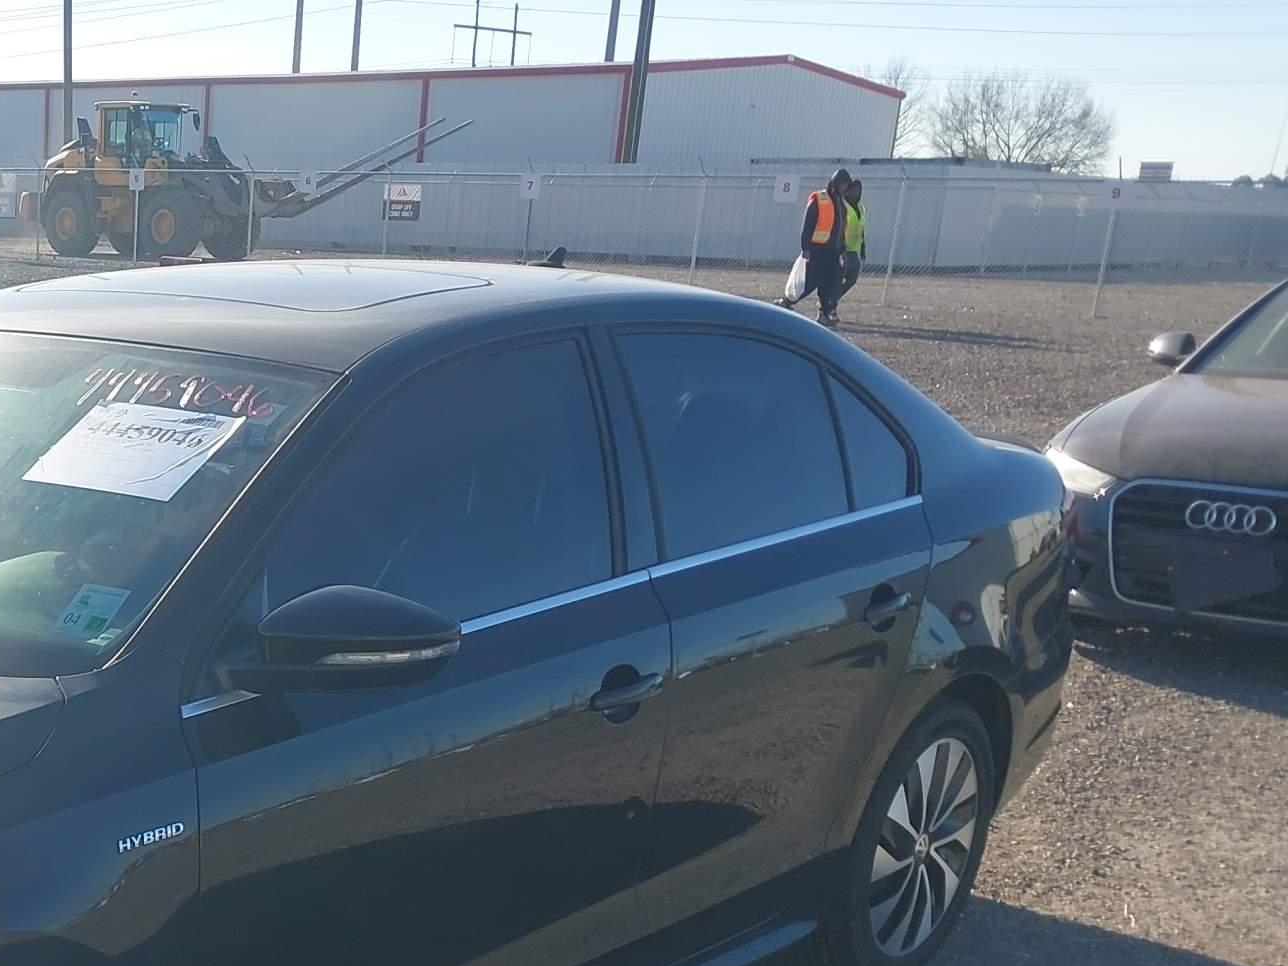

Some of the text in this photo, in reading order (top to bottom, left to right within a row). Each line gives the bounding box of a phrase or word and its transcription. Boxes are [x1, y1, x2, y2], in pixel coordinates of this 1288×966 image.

[134, 175, 140, 183] 5
[527, 180, 534, 190] 7
[783, 182, 791, 193] 8
[1111, 187, 1121, 200] 9
[63, 612, 82, 626] 04
[117, 821, 185, 854] HYBRID
